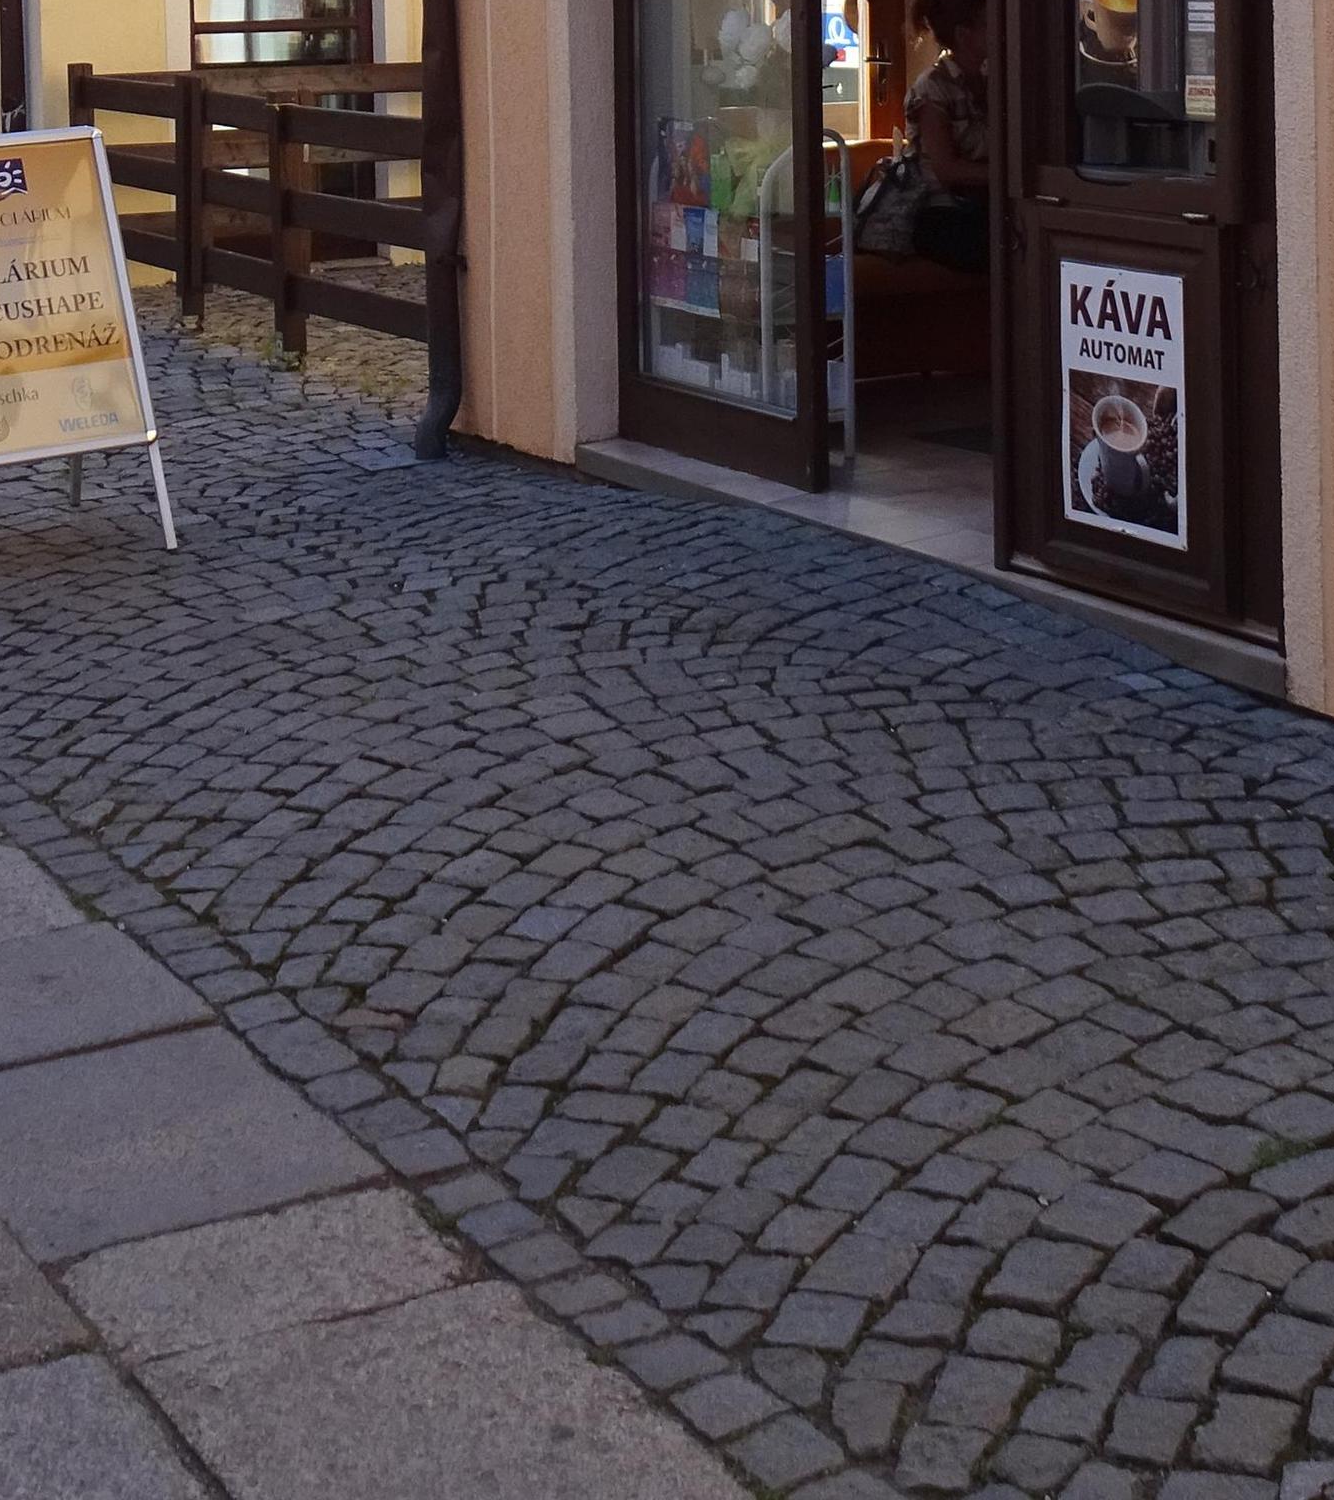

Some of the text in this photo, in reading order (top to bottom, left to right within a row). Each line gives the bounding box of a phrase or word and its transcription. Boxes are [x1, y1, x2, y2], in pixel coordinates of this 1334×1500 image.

[1069, 279, 1173, 341] KÁVA
[1079, 337, 1165, 371] AUTOMAT
[58, 411, 120, 433] WELEDA
